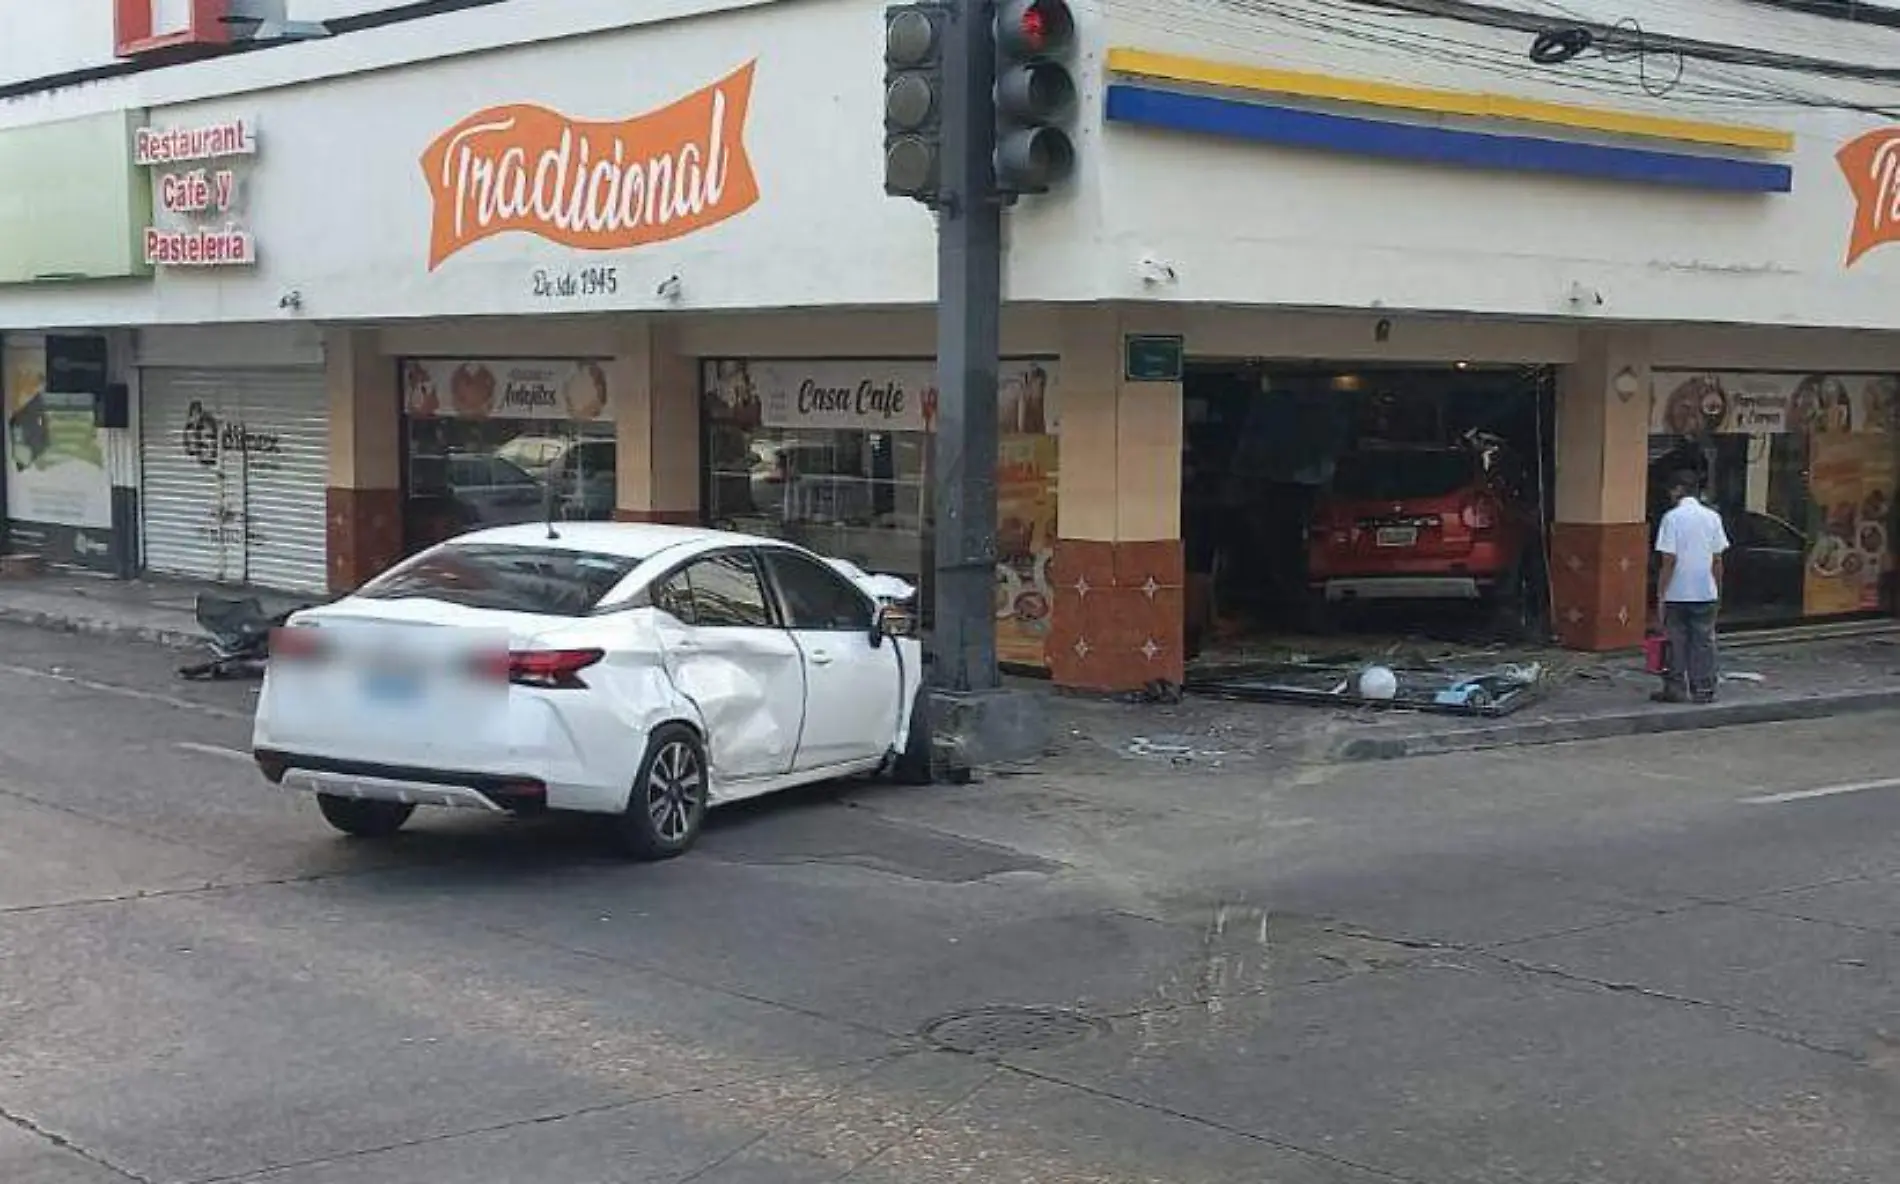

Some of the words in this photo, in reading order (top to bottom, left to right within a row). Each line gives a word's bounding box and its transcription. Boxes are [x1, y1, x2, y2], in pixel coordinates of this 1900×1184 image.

[137, 117, 246, 161] Restaurant
[443, 88, 728, 238] Tradicional
[580, 268, 617, 295] 1945
[797, 379, 850, 414] Casa
[855, 379, 905, 419] Café
